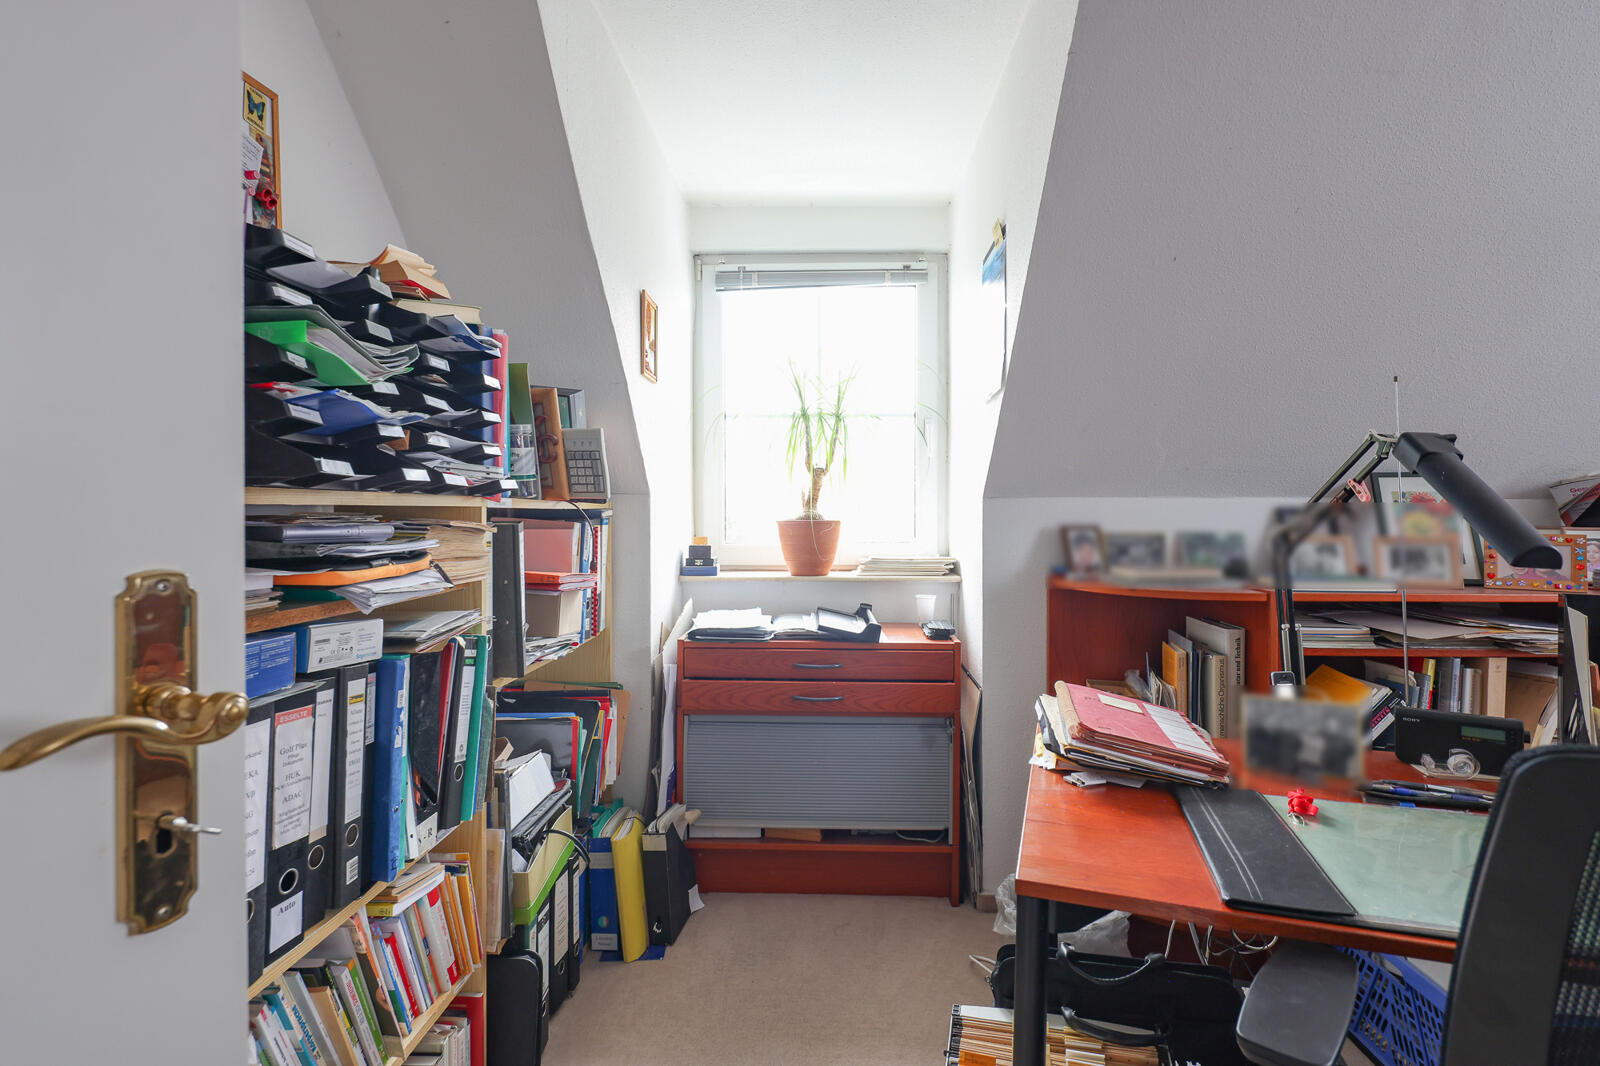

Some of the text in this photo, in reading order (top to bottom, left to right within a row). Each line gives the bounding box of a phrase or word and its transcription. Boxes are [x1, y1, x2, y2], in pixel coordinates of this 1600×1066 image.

[279, 710, 309, 723] ESSELTE
[280, 744, 295, 755] Golf
[282, 791, 303, 804] ADAC
[278, 900, 296, 915] Auto
